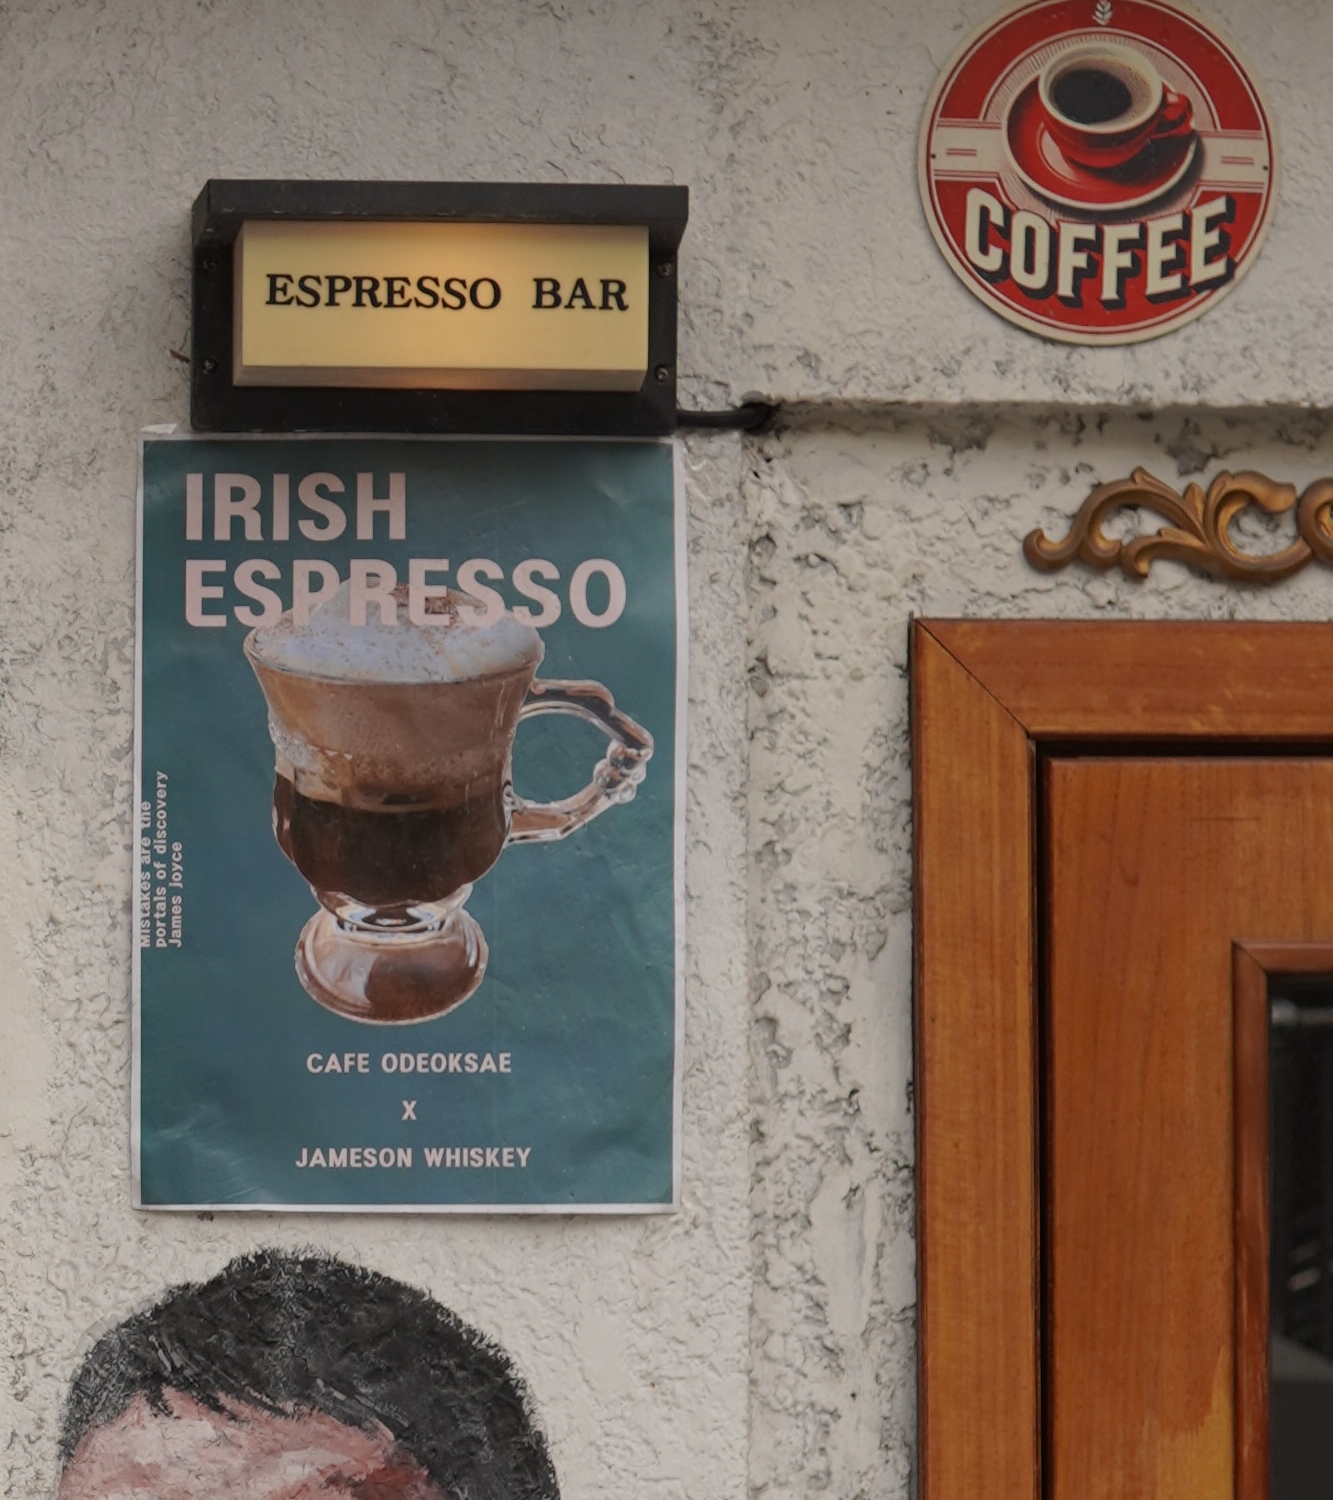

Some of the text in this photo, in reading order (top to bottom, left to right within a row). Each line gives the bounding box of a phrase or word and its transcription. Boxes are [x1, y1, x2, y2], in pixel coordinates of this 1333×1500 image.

[964, 187, 1236, 310] COFFEE
[265, 273, 630, 311] ESPRESSO BAR
[185, 472, 407, 541] IRISH
[184, 558, 627, 628] ESPRESSO
[141, 800, 152, 948] Mistakes are the
[153, 771, 169, 948] portals of discovery
[168, 894, 183, 948] James
[306, 1052, 512, 1075] CAFE ODEOKSAE
[295, 1147, 532, 1168] JAMESON WHISKEY
